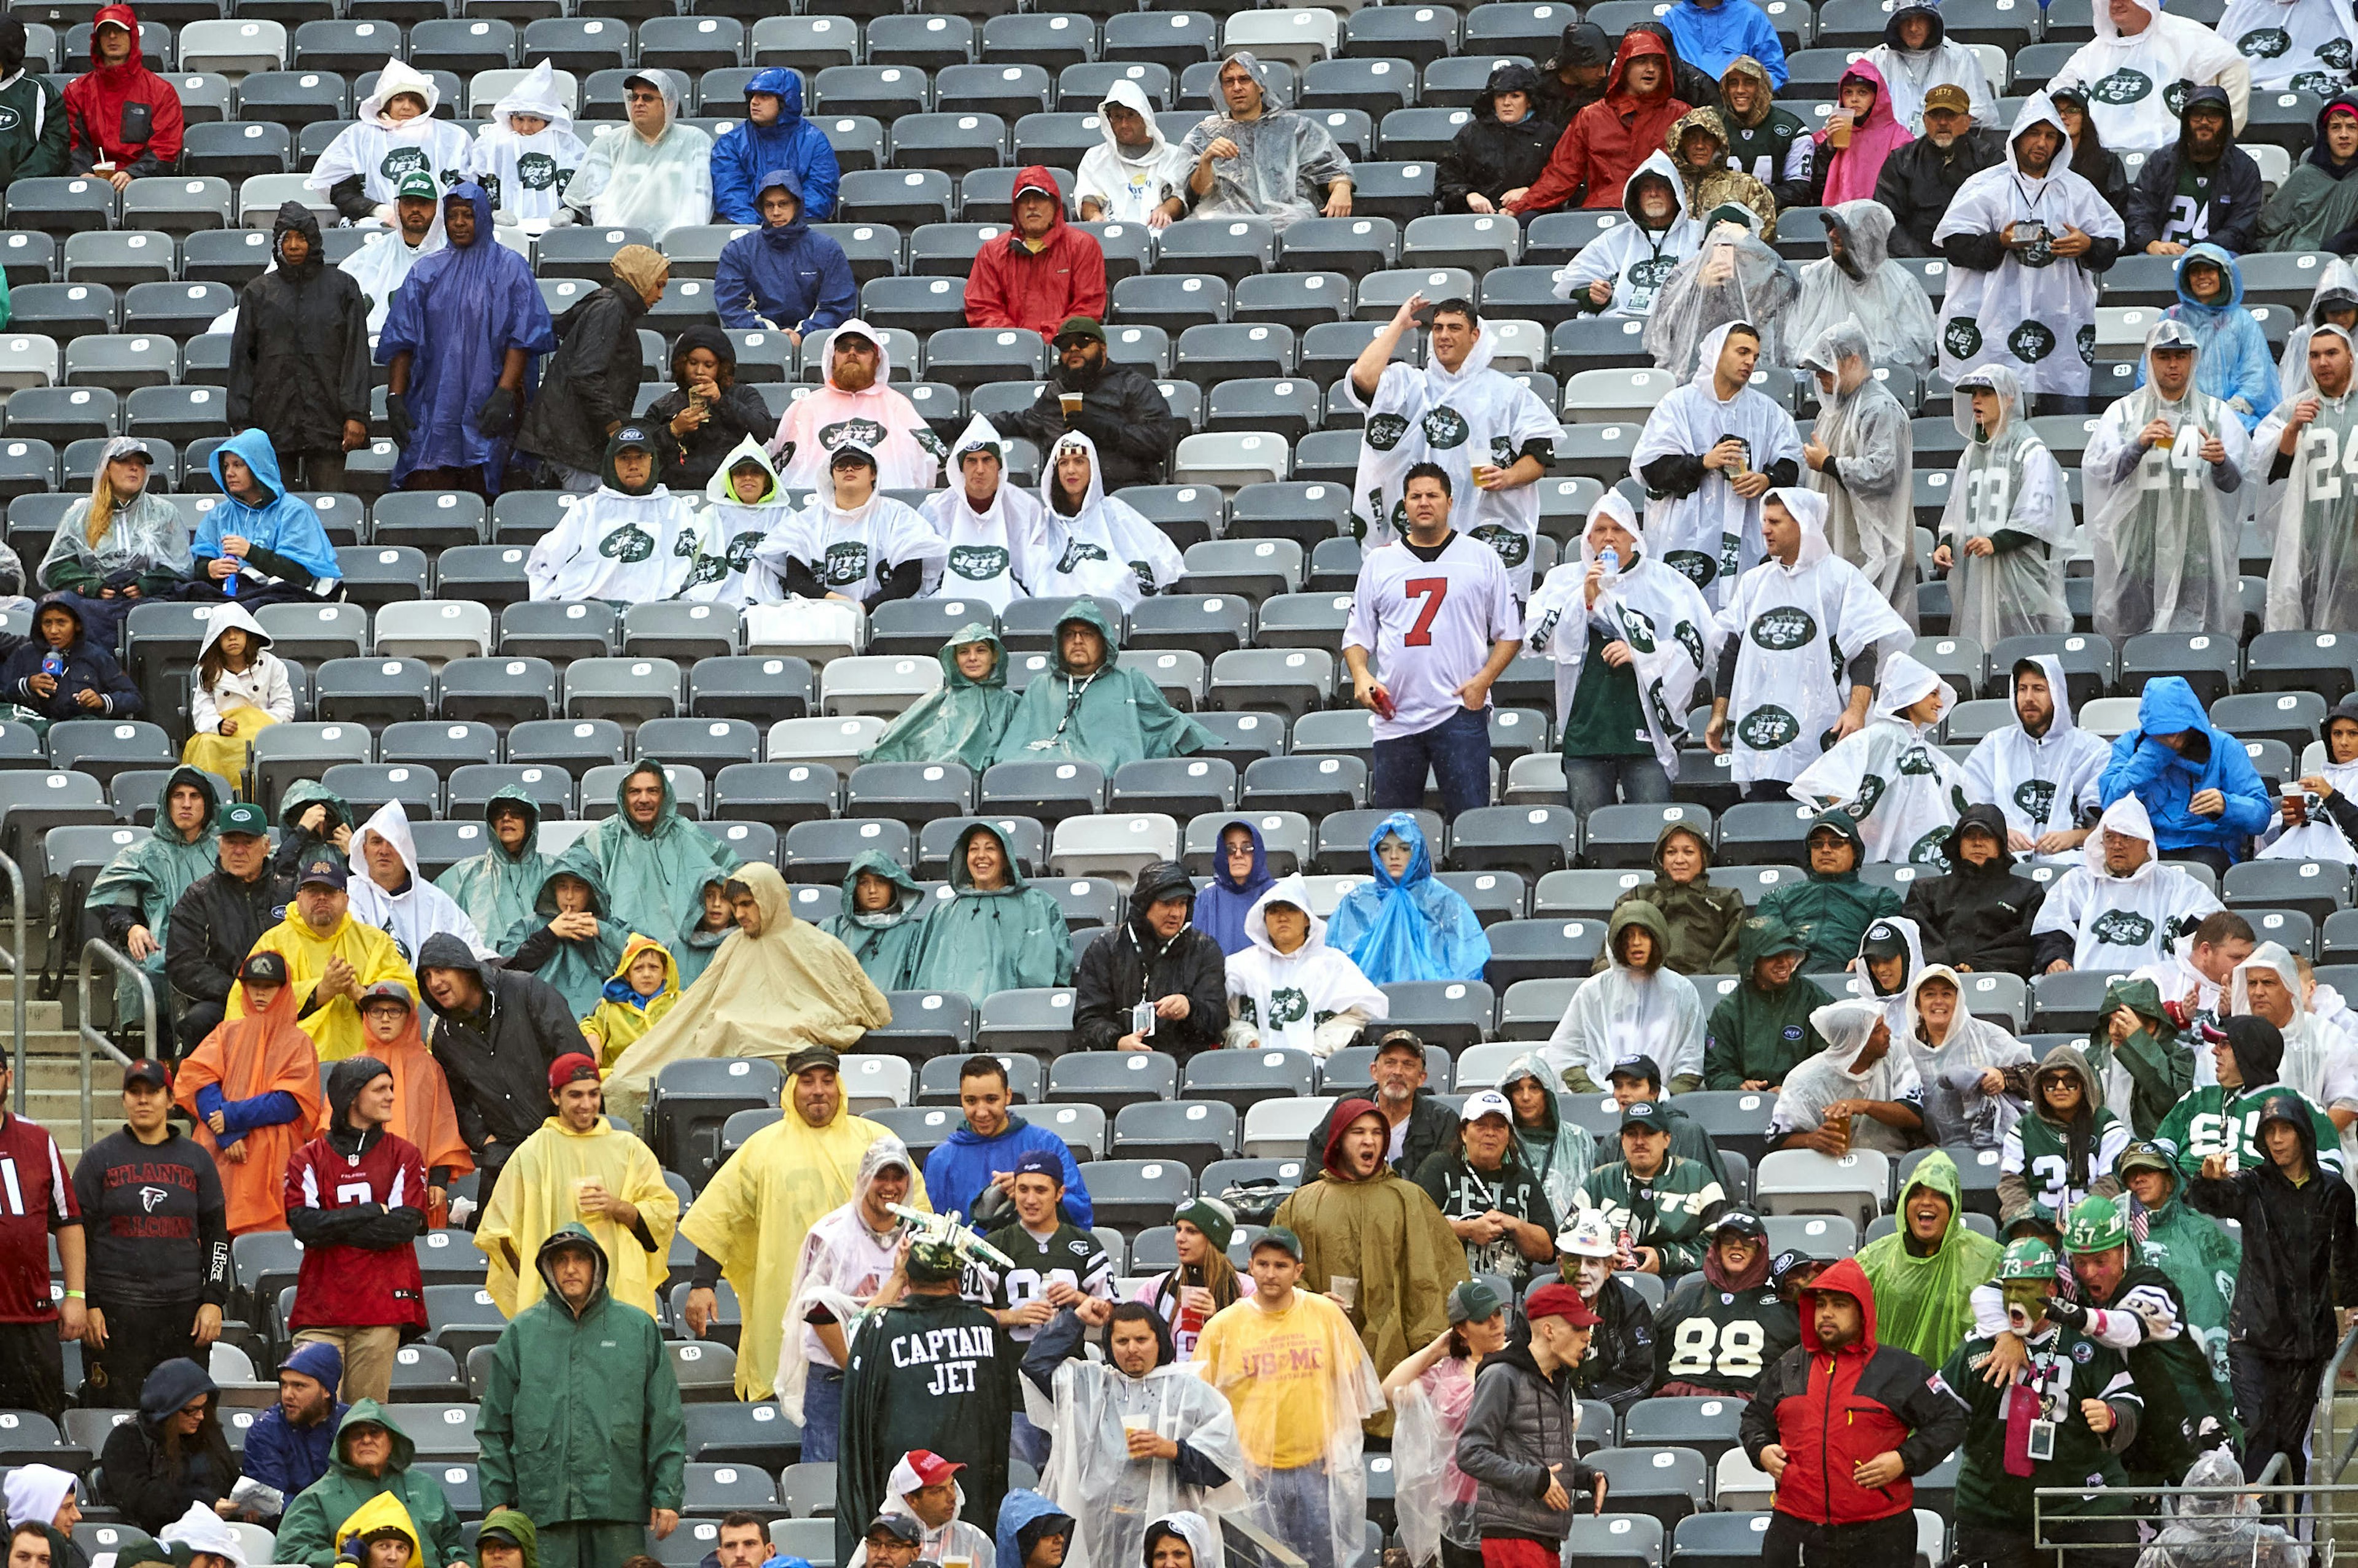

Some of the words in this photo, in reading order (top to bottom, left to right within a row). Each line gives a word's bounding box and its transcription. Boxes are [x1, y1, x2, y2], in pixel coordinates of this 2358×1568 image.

[1934, 88, 1953, 96] JETS
[2105, 81, 2142, 92] ETS
[2162, 194, 2209, 243] 24
[827, 427, 877, 448] JETS
[952, 555, 1002, 569] JETS
[1404, 577, 1447, 647] 7
[1757, 620, 1805, 637] JETS
[1747, 720, 1788, 737] JETS
[2074, 1227, 2096, 1244] 57
[2001, 1259, 2021, 1279] 73
[890, 1325, 994, 1368] CAPTAIN
[1668, 1318, 1765, 1379] 88
[927, 1360, 977, 1396] JET
